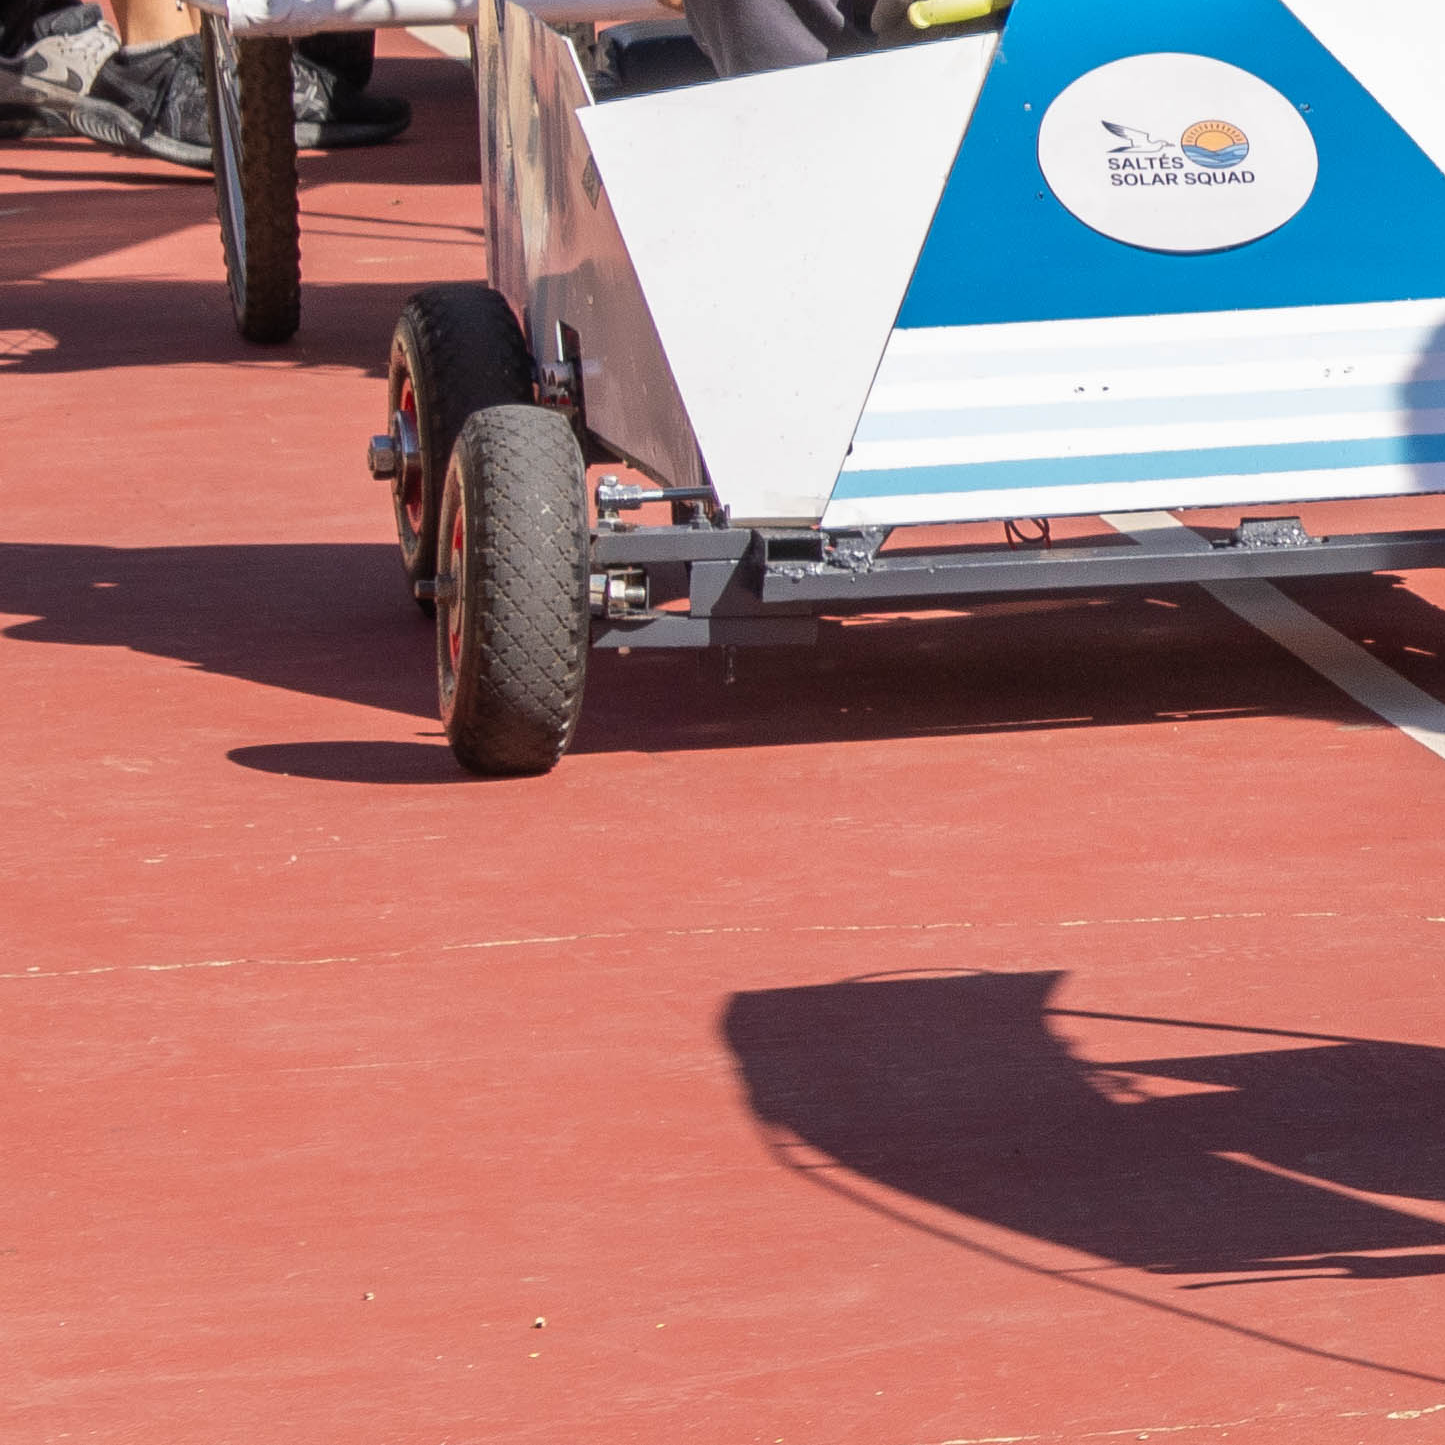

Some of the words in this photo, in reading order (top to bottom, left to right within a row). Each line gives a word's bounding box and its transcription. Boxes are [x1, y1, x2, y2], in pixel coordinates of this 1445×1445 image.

[1108, 153, 1184, 170] SALTÉS
[1111, 172, 1178, 187] SOLAR
[1184, 170, 1255, 187] SQUAD
